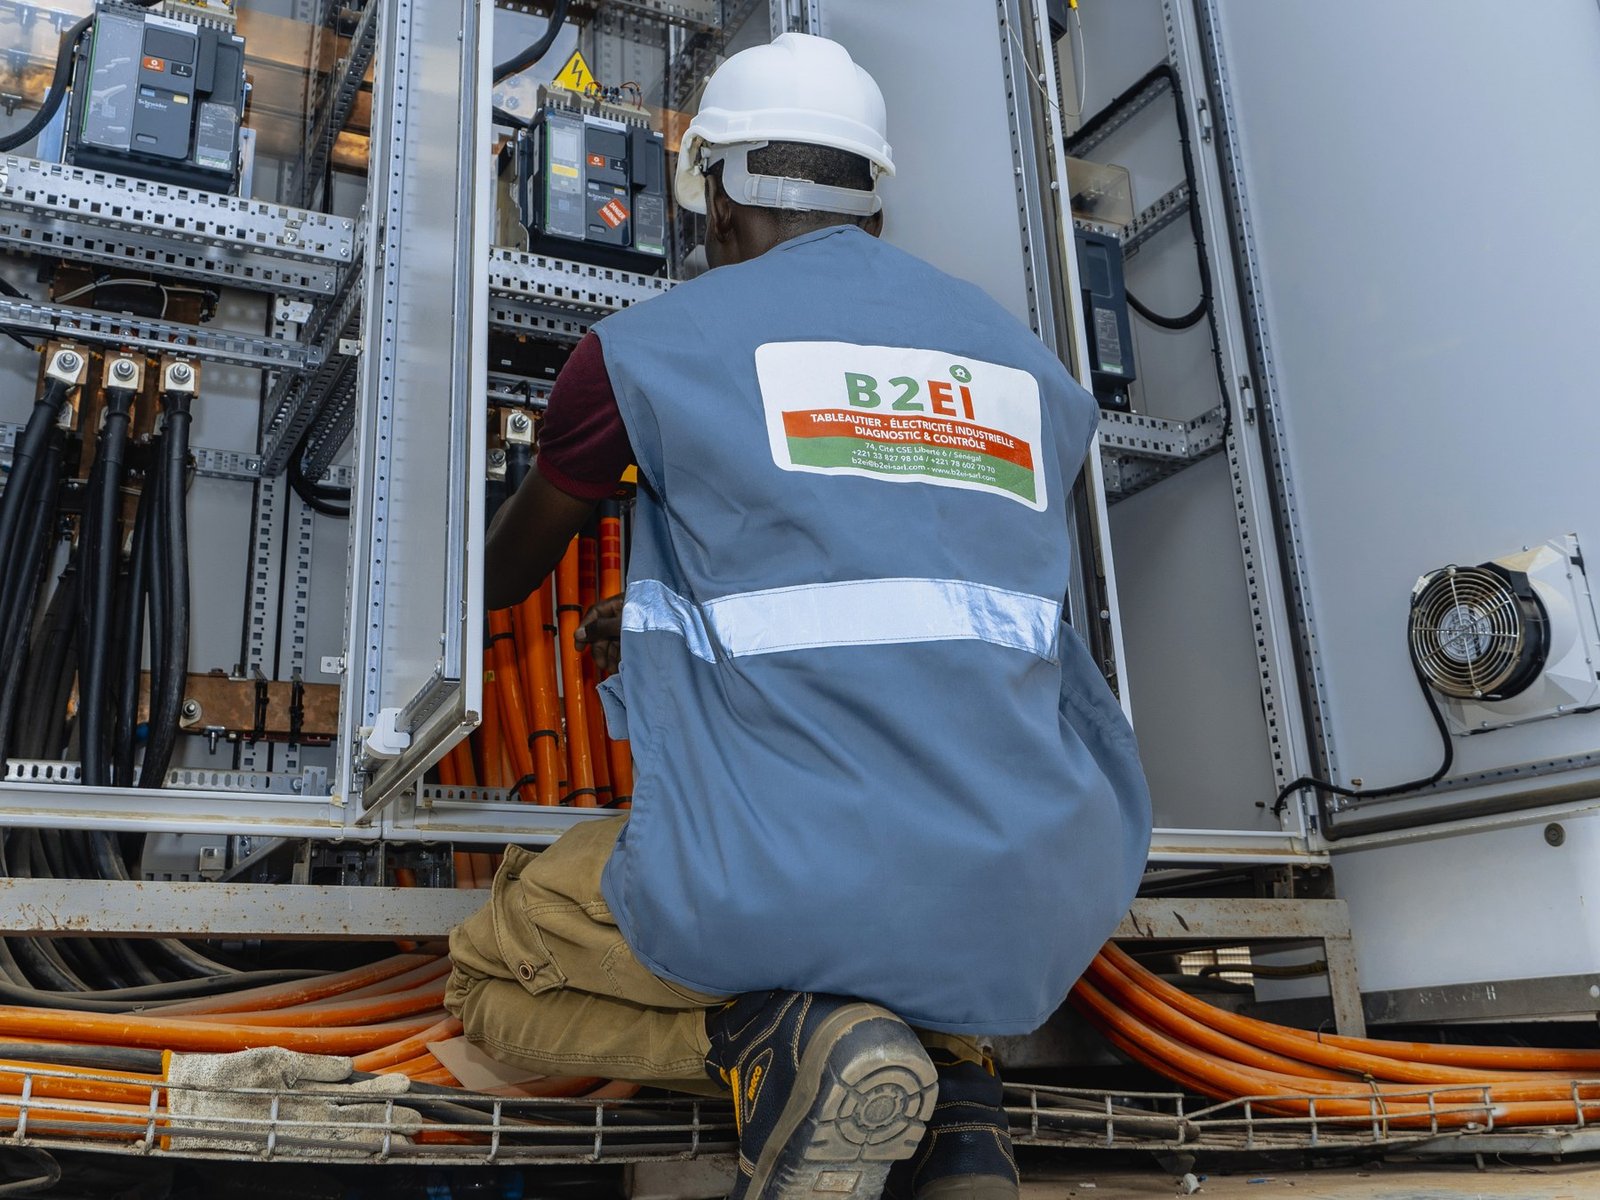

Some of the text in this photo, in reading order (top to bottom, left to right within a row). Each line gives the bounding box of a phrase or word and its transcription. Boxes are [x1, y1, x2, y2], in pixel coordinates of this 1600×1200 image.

[810, 414, 882, 427] TABLEAUTIER
[890, 418, 952, 433] ÉLECTRICITÉ
[955, 426, 1014, 448] INDUSTRIELLE
[854, 426, 986, 450] DIAGNOSTIC & CONTRÔLE
[852, 450, 870, 458] +221
[986, 465, 996, 474] 70
[914, 446, 940, 456] Liberté
[954, 452, 982, 462] Sénégal
[852, 457, 926, 470] b2ei@b2ei-sarl.com
[931, 467, 996, 482] www.b2ei-sarl.com
